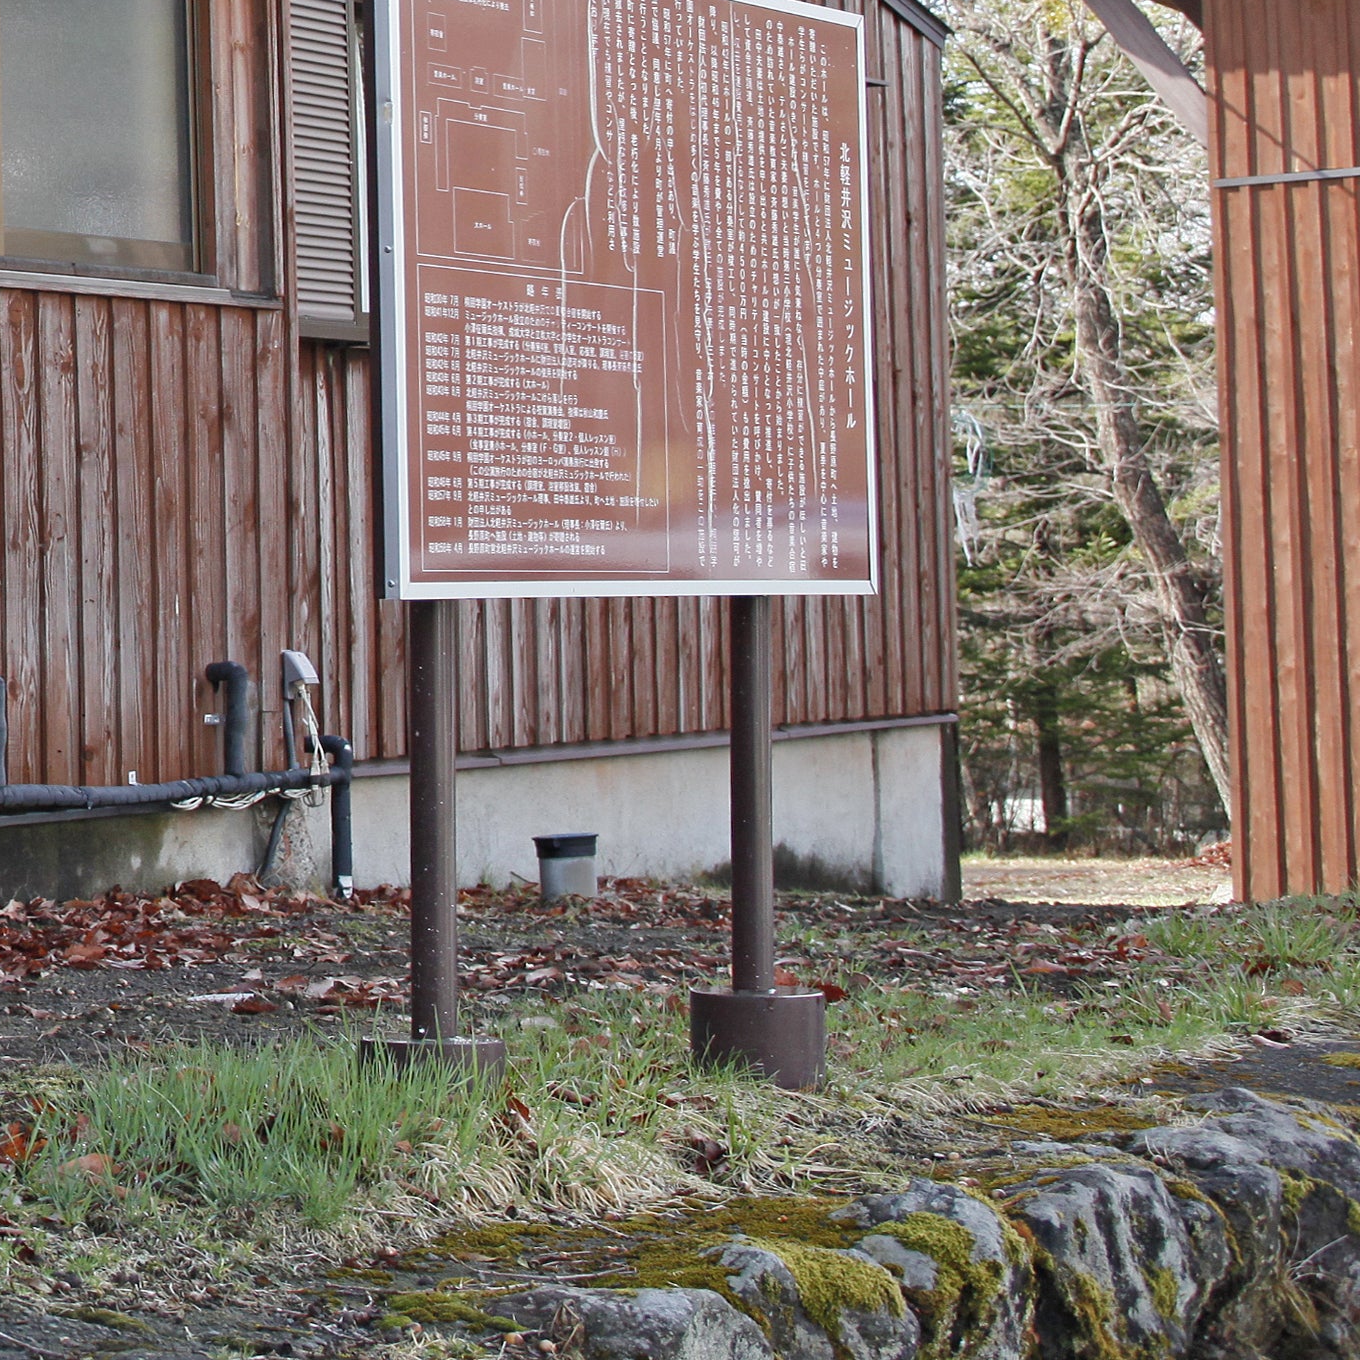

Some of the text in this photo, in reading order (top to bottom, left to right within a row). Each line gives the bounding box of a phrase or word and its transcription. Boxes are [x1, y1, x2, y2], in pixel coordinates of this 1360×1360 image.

[837, 139, 856, 431] 北軽井沢ミュージックホール
[450, 334, 459, 346] 7月
[450, 347, 460, 359] 7月
